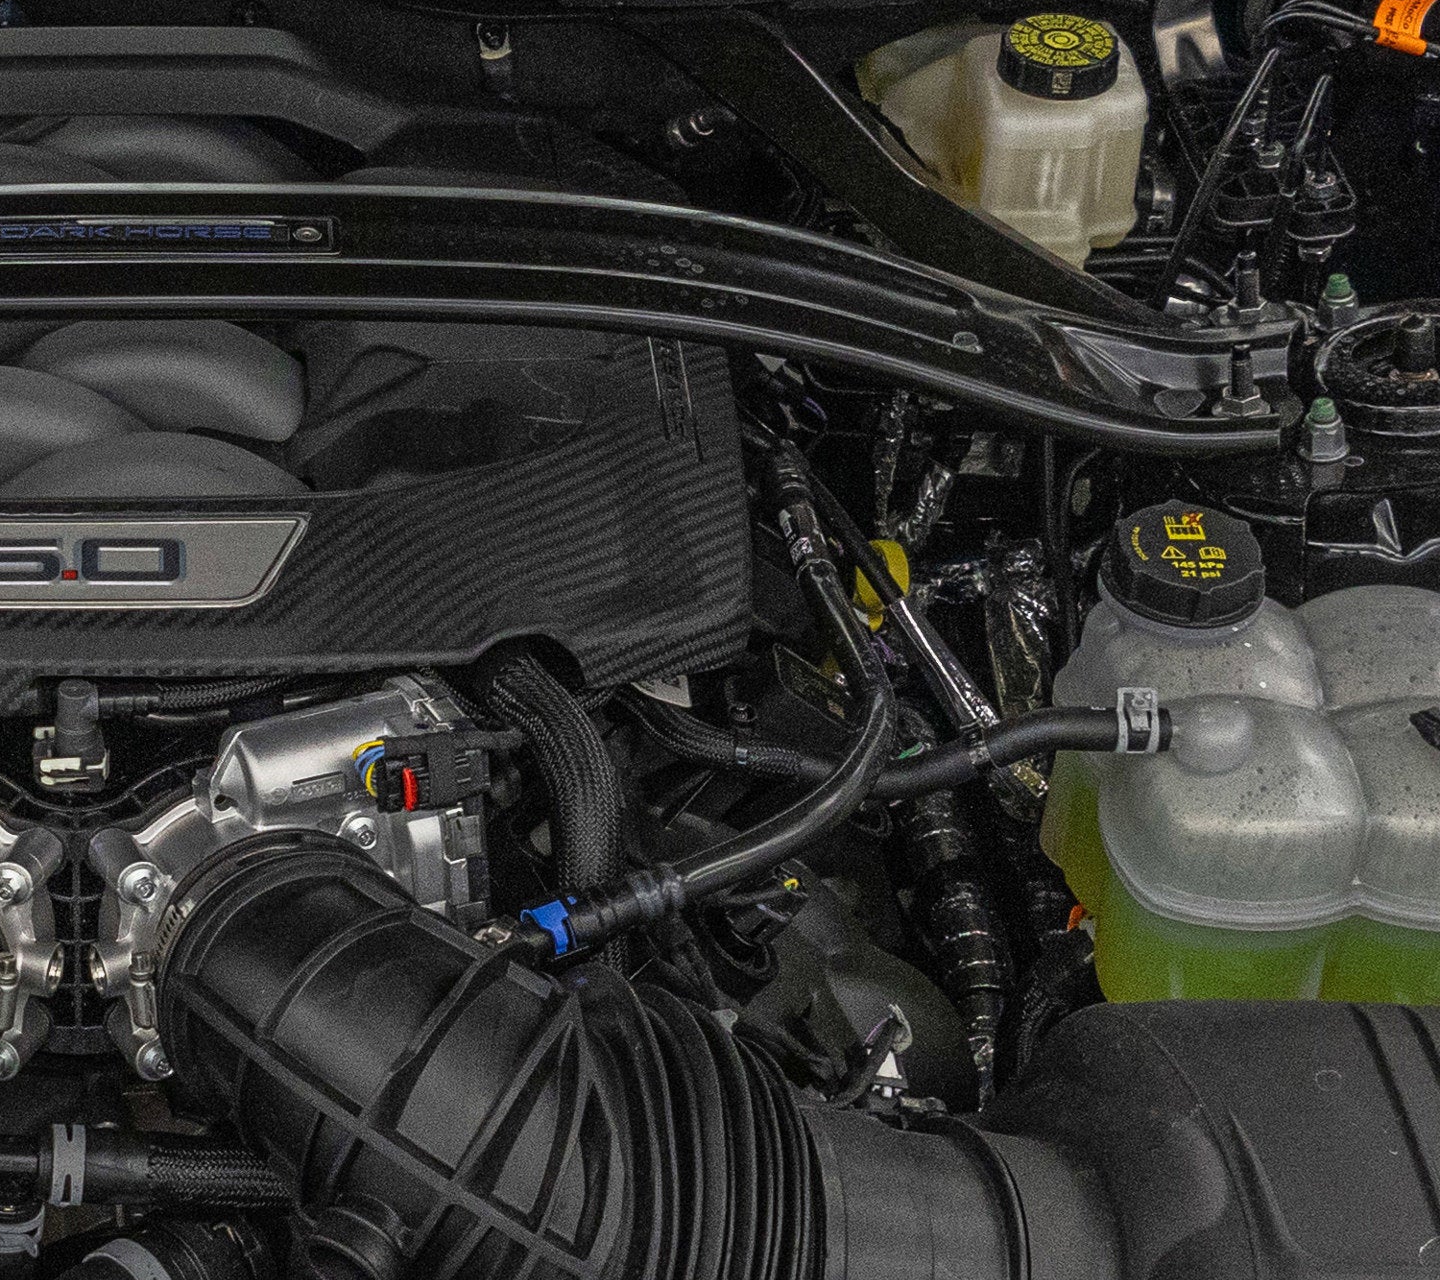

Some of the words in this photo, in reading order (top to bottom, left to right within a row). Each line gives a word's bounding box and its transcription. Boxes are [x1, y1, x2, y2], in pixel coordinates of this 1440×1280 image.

[0, 225, 114, 240] DARK
[125, 224, 272, 240] HORSE
[1171, 561, 1197, 569] 145
[1198, 561, 1226, 570] kPa
[1180, 570, 1197, 578] 21
[1200, 570, 1222, 580] psi
